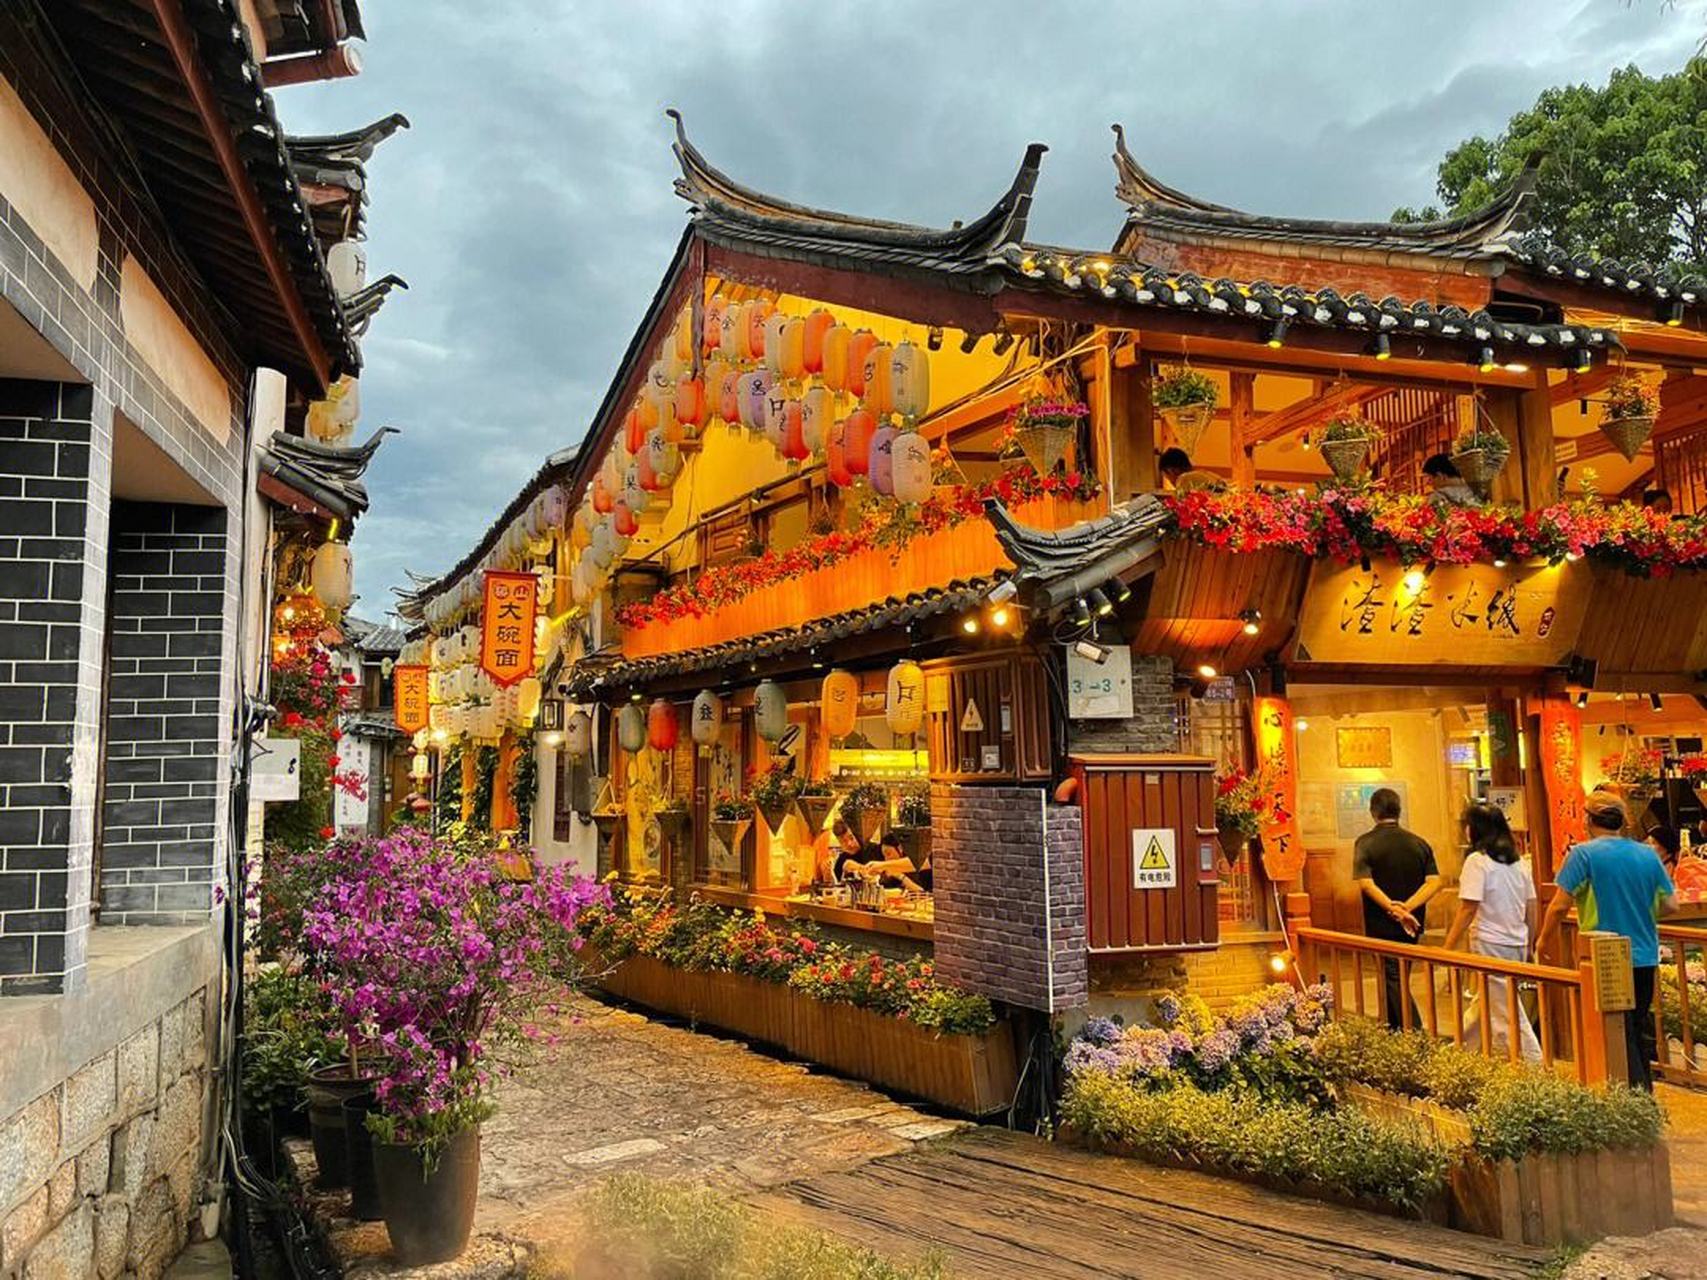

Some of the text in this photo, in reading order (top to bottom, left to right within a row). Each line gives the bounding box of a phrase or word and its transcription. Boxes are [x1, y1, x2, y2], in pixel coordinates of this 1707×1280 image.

[494, 601, 522, 667] 大碗面
[1139, 872, 1171, 882] 有电危险
